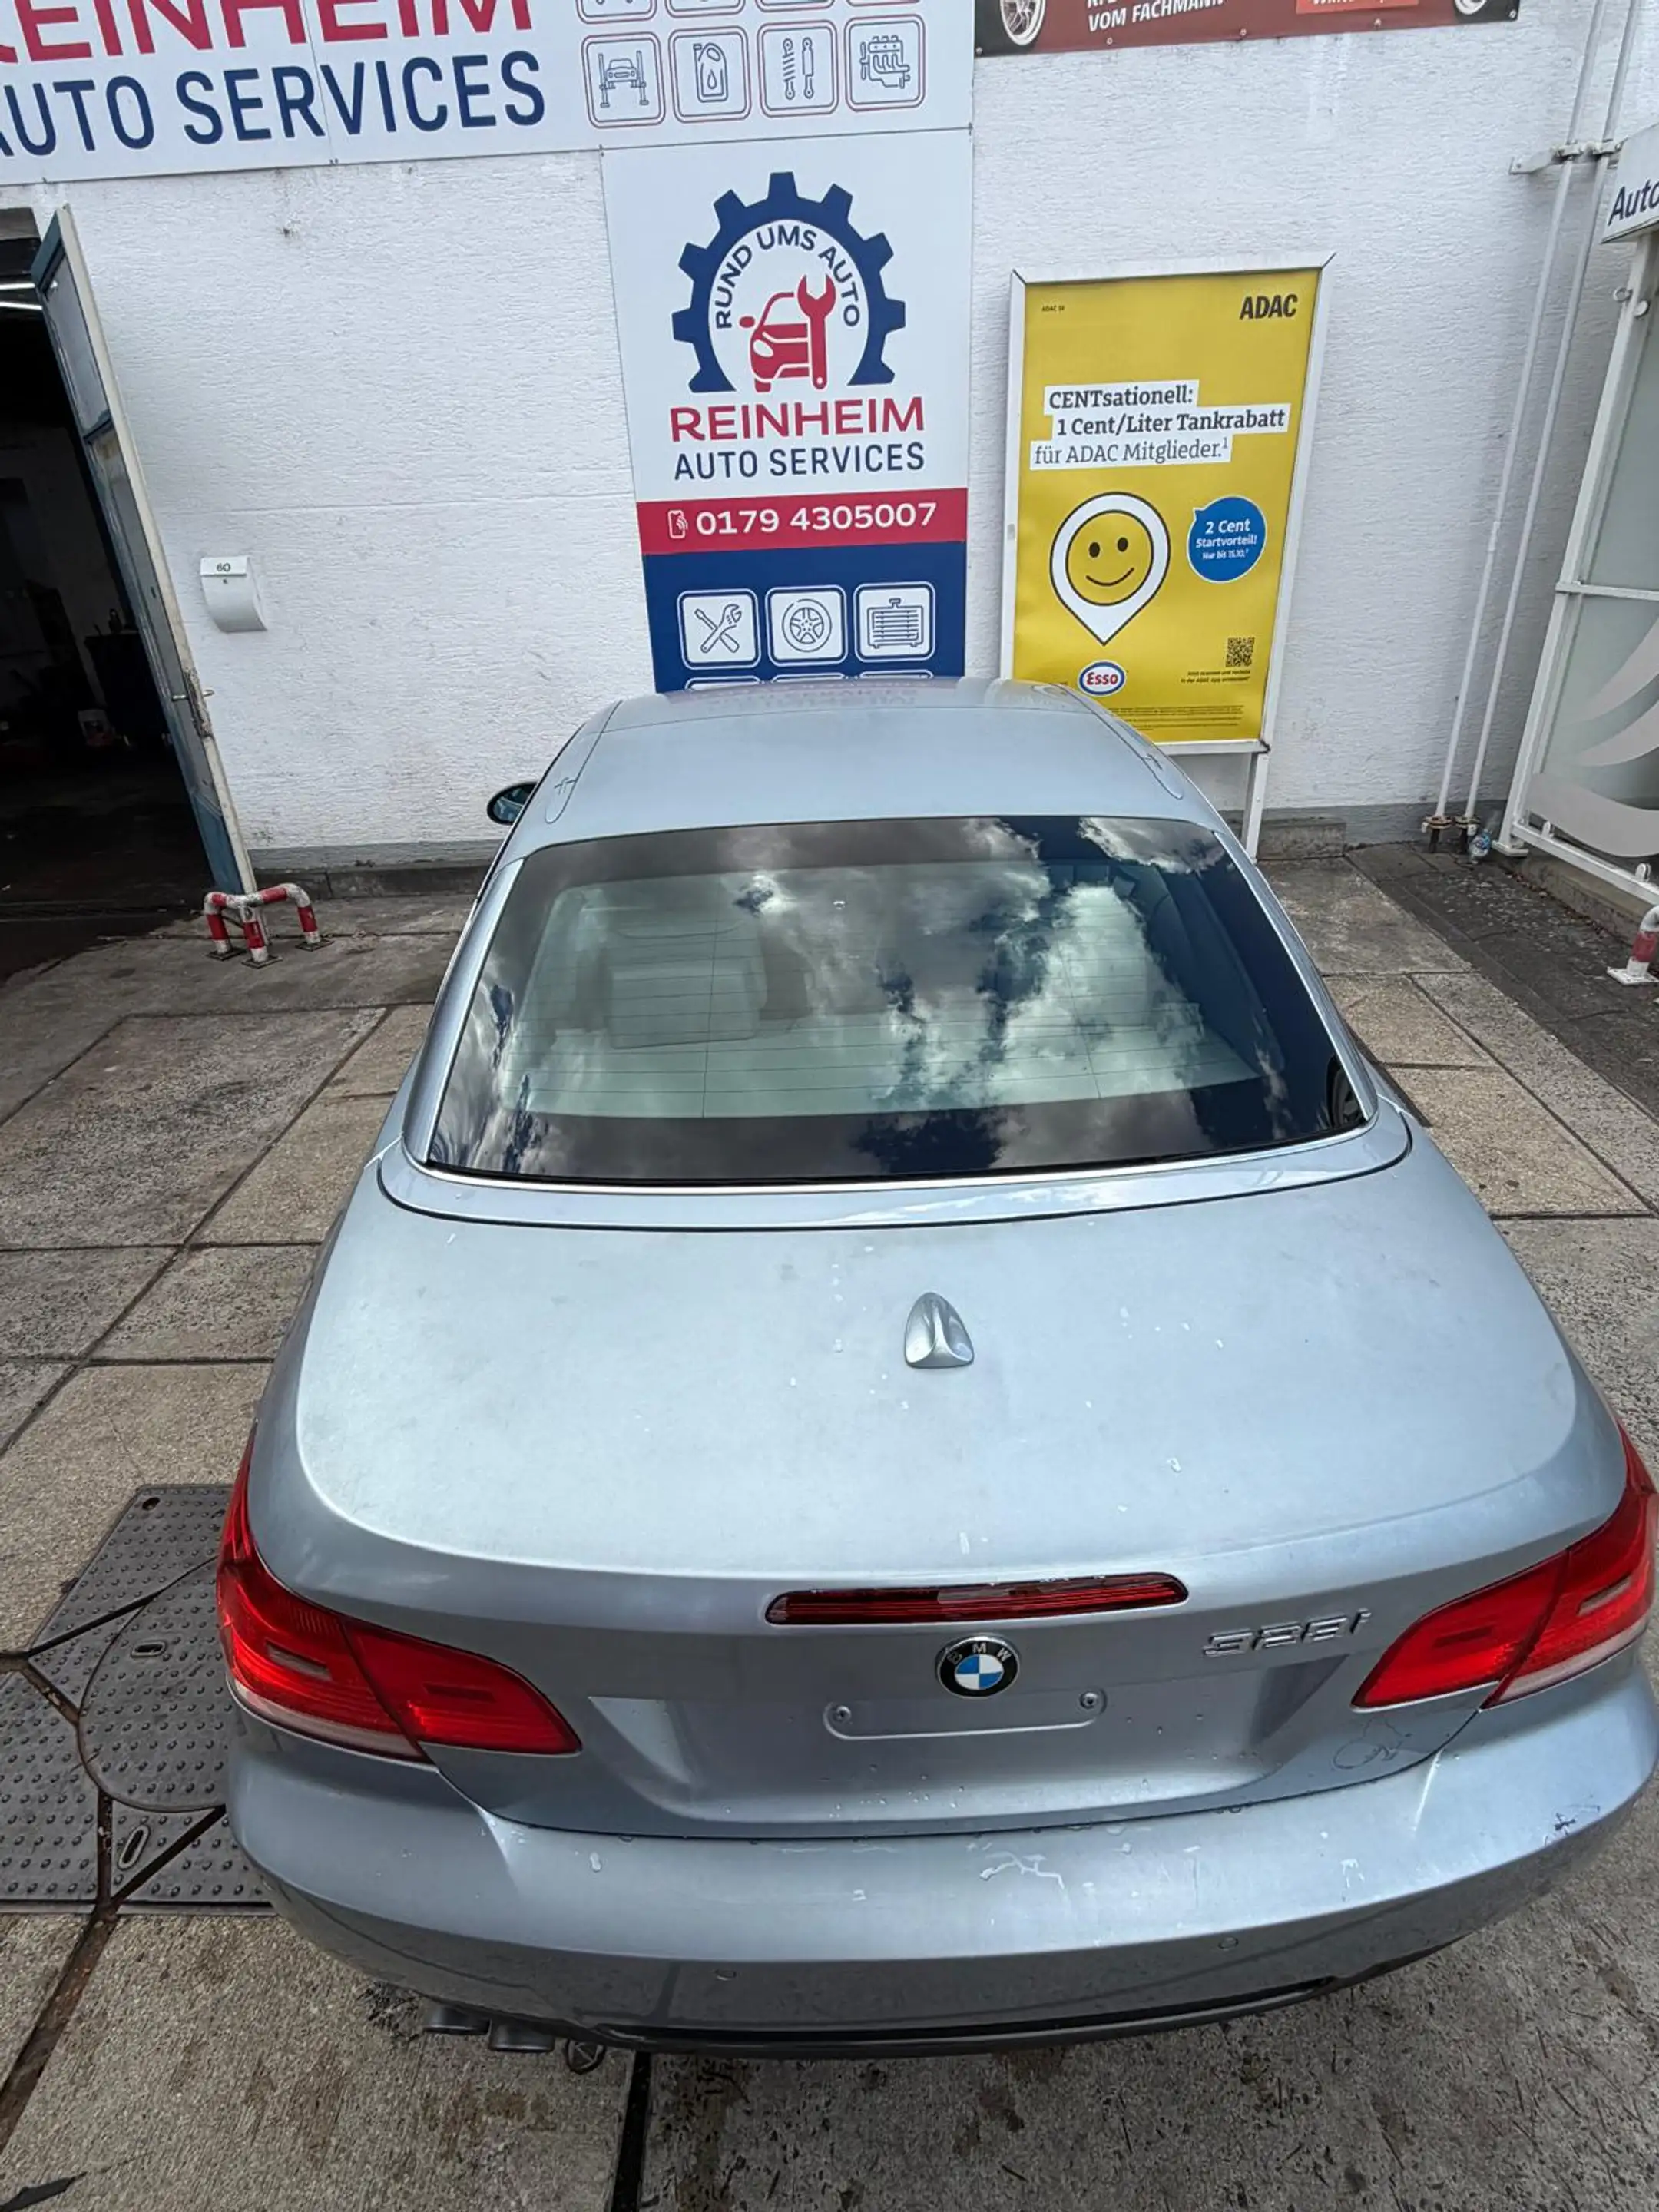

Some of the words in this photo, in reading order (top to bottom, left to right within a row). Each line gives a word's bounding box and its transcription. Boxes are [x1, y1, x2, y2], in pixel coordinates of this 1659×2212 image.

[1088, 8, 1127, 32] VOM
[1132, 0, 1224, 23] FACHMA
[0, 75, 154, 157] UTO
[176, 51, 545, 141] SERVICES
[715, 244, 753, 329] RUND
[756, 224, 817, 252] UMS
[818, 246, 860, 327] AUTO
[1239, 293, 1298, 320] ADAC
[1049, 385, 1194, 409] CENTsationell:
[670, 396, 924, 442] REINHEIM
[1057, 419, 1067, 436] 1
[1071, 413, 1173, 435] Cent/Liter
[1177, 409, 1286, 430] Tankrabatt
[674, 449, 758, 481] AUTO
[770, 442, 926, 476] SERVICES
[1035, 445, 1062, 465] für
[1066, 445, 1118, 463] ADAC
[696, 508, 780, 535] 0179
[790, 502, 938, 531] 4305007
[1205, 522, 1214, 535] 2
[1218, 518, 1251, 534] Cent
[1196, 534, 1258, 548] Startvorteil!
[217, 563, 231, 572] 60
[1086, 671, 1119, 685] Esso
[947, 1642, 1012, 1665] BMW
